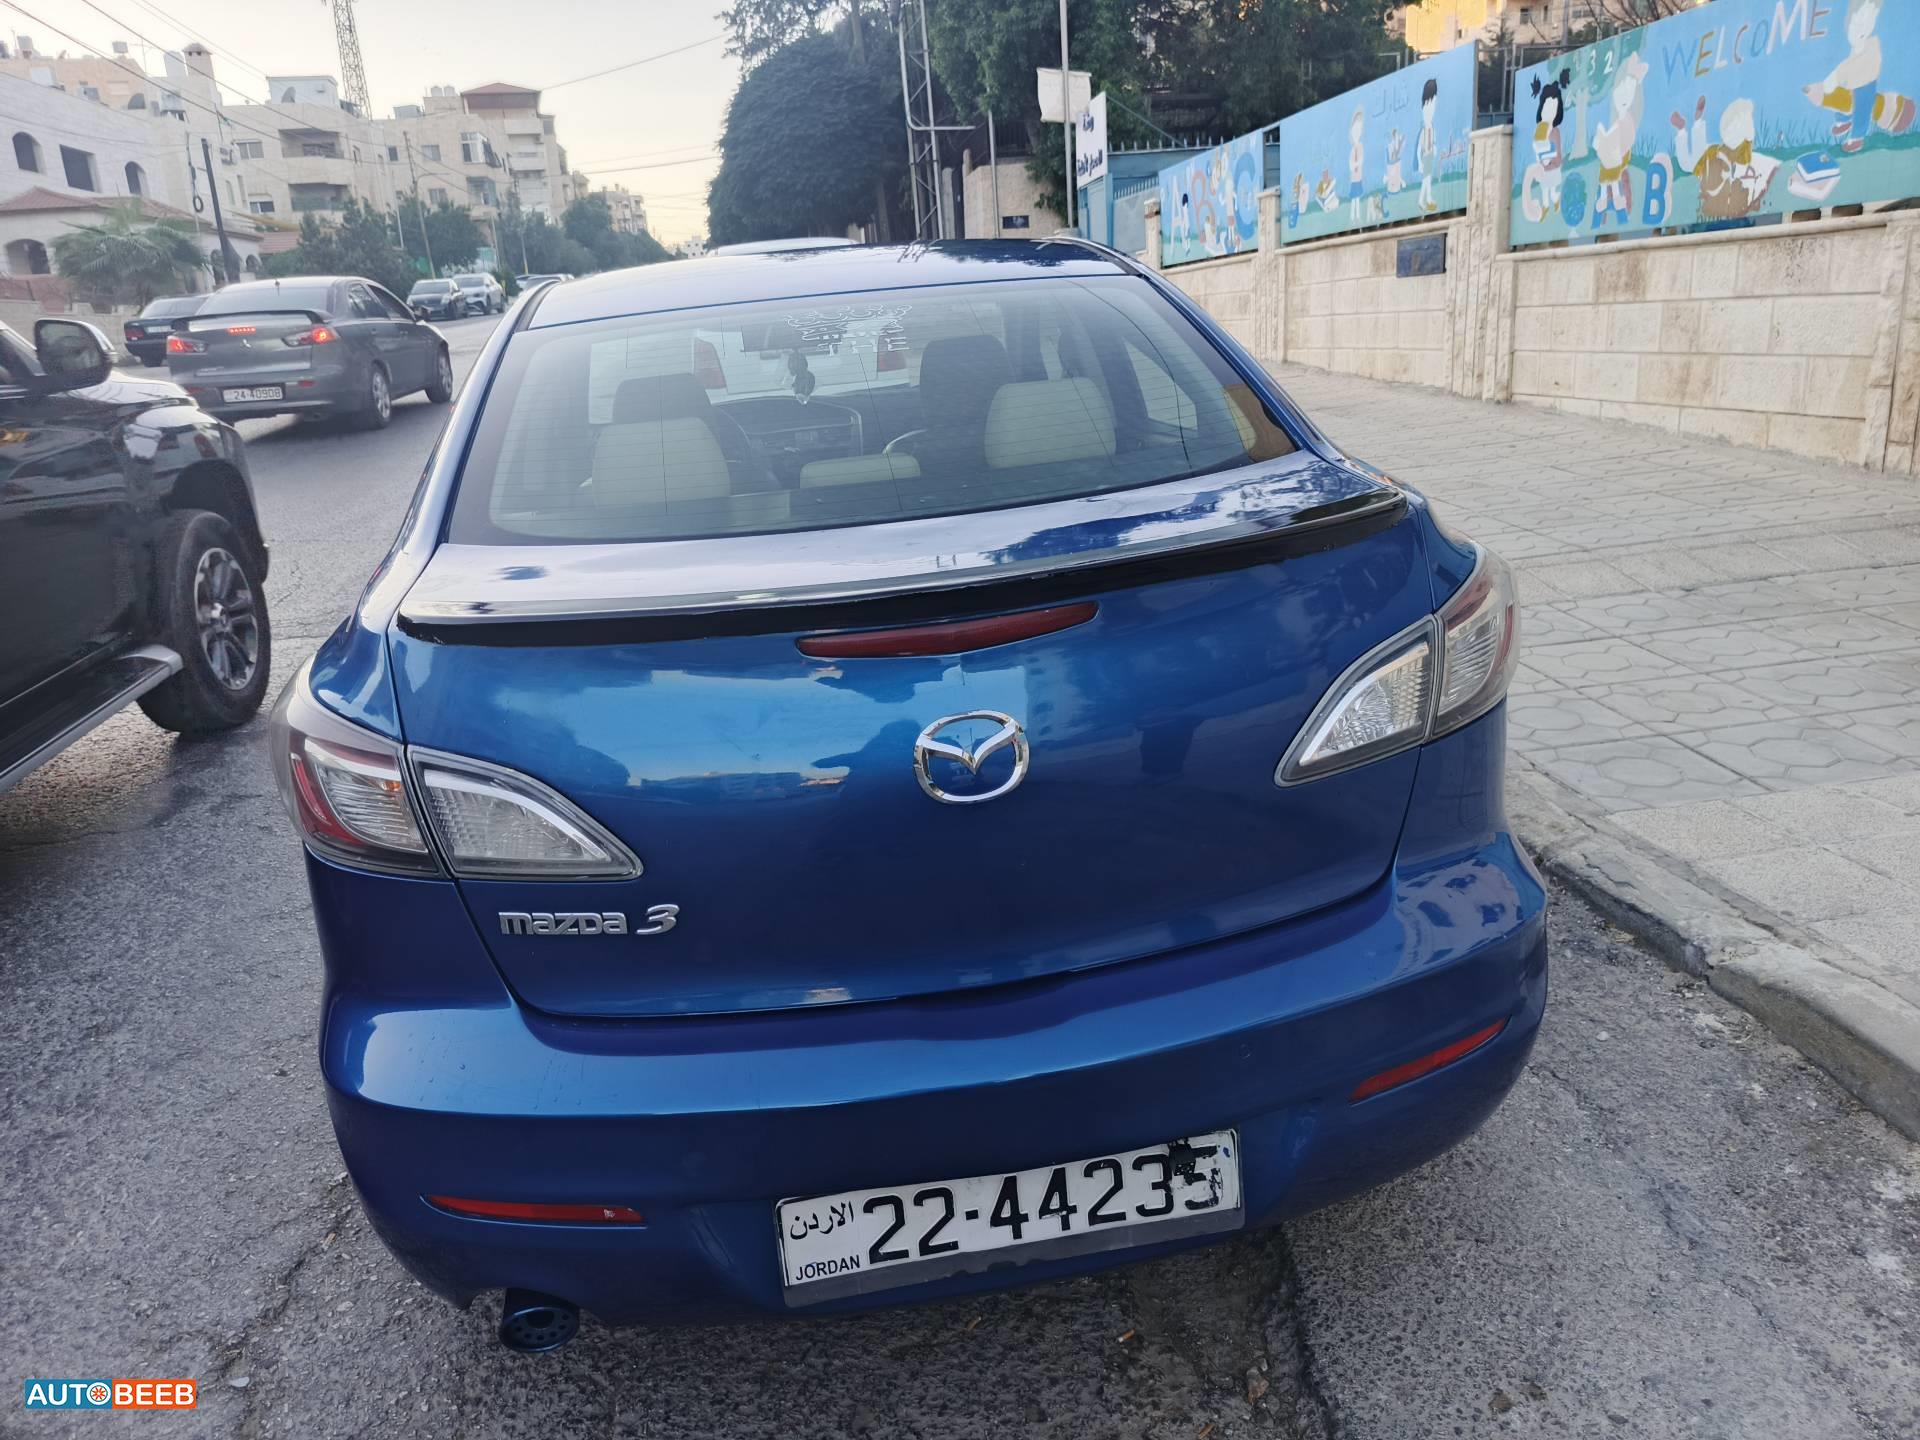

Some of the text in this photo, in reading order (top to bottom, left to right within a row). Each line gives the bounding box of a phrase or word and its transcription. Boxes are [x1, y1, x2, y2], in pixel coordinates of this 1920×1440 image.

[1661, 0, 1831, 84] WELCOME
[635, 903, 681, 936] 3
[795, 1254, 862, 1282] JORDAN
